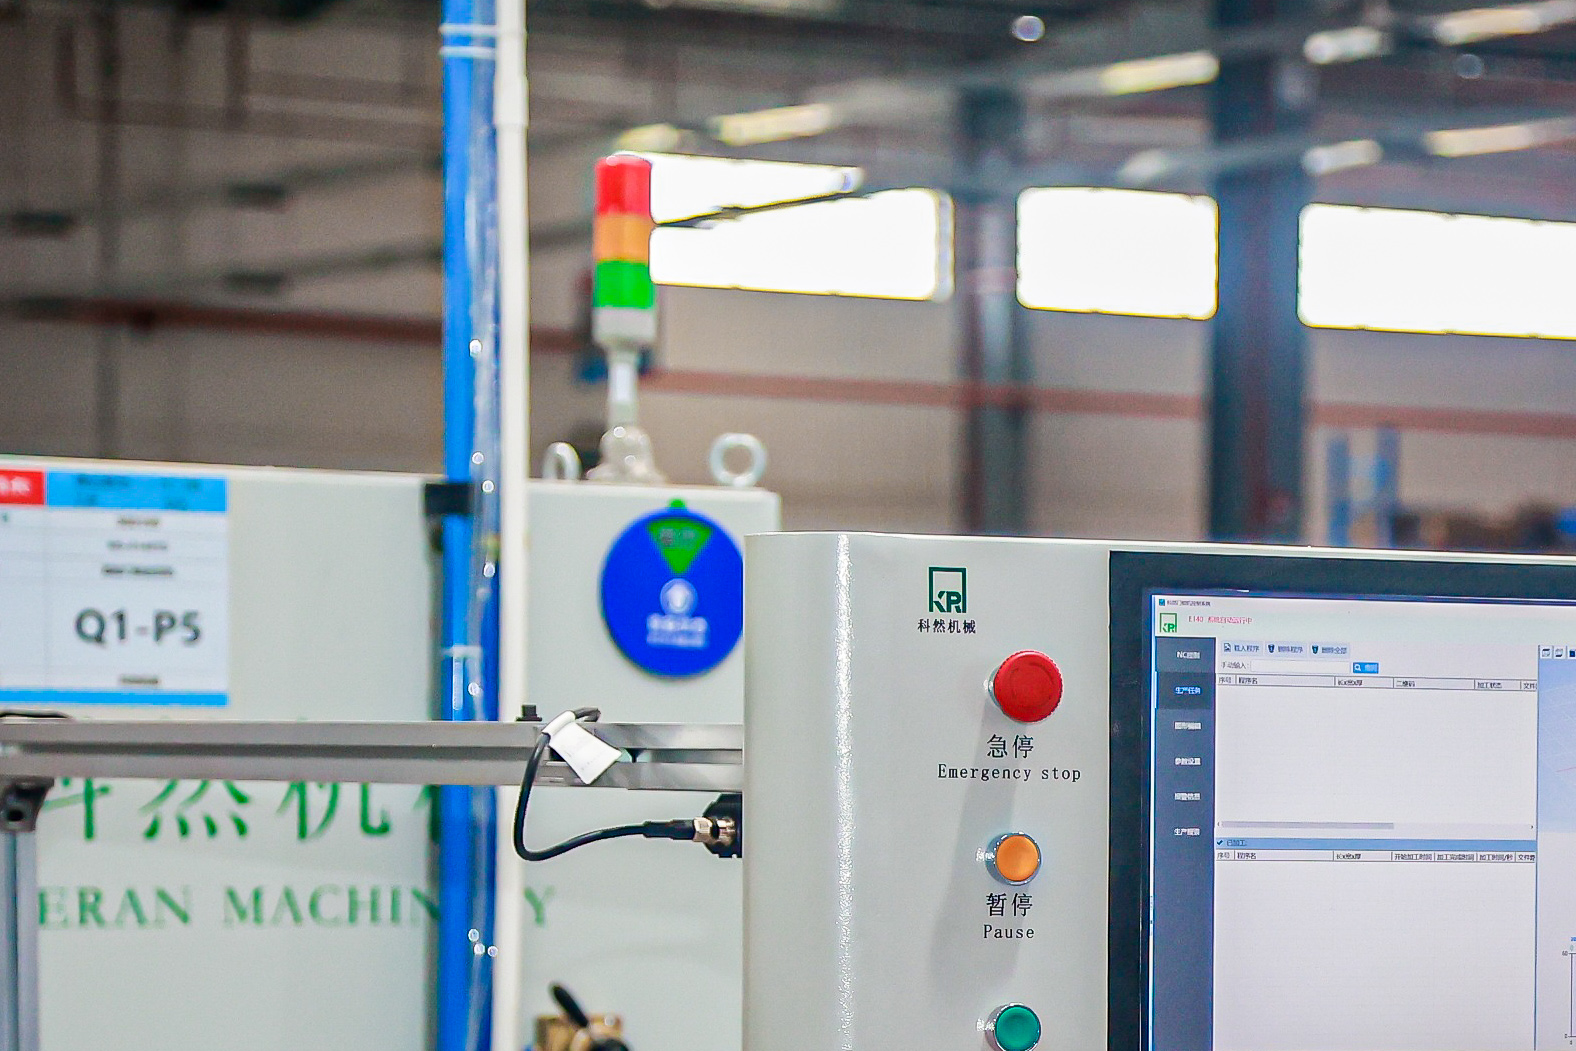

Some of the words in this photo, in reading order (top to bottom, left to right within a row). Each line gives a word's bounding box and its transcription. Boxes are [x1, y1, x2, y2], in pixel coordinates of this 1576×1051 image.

[75, 608, 202, 647] Q1-P5
[917, 618, 976, 634] 科然机械
[986, 734, 1034, 759] 急停
[937, 763, 1032, 782] Emergency
[1041, 767, 1082, 783] stop
[37, 886, 194, 929] ERAN
[222, 884, 556, 929] MACHINY
[986, 892, 1034, 917] 暂停
[983, 924, 1035, 939] Pause
